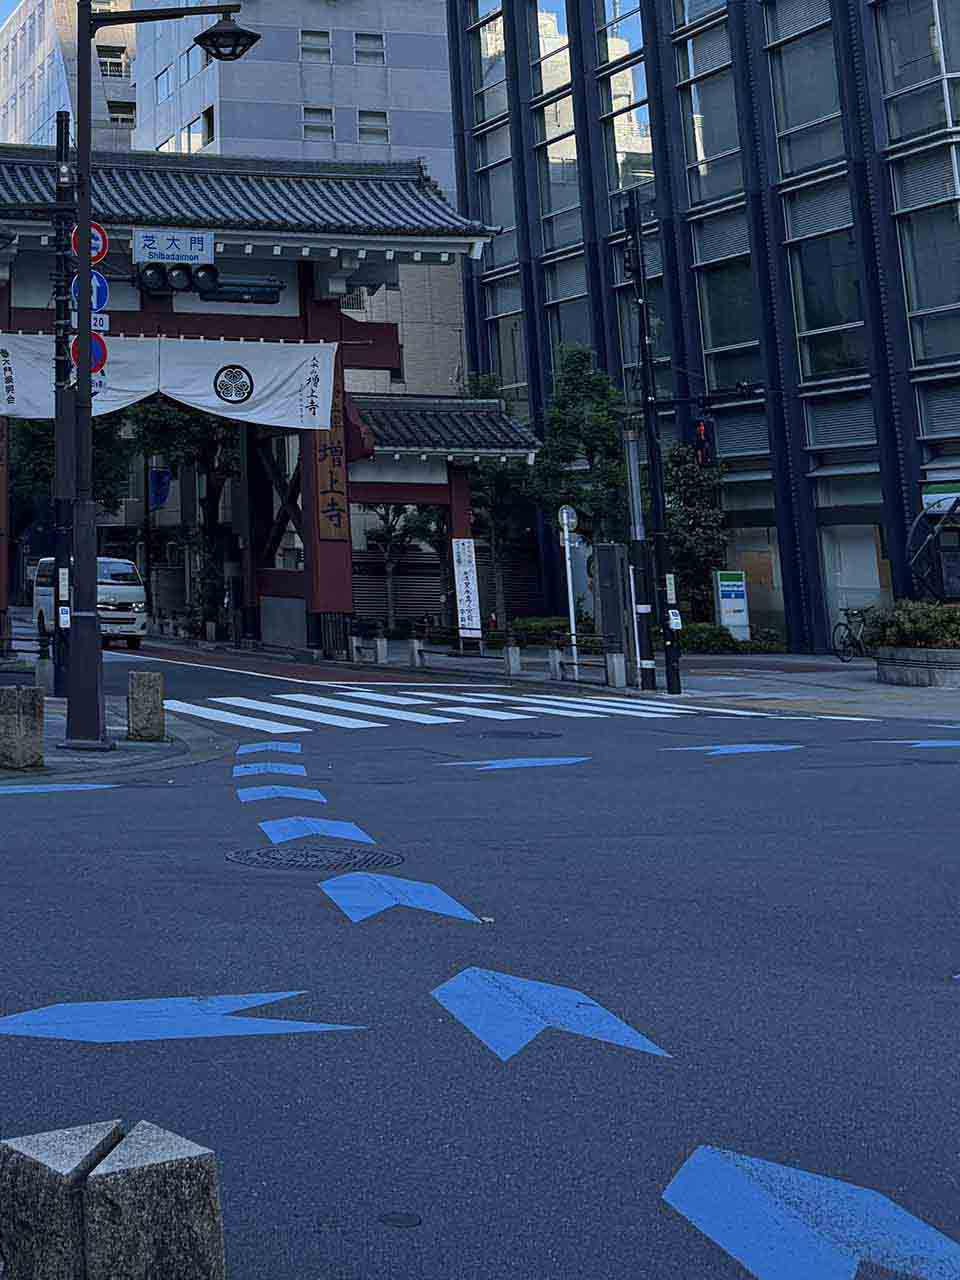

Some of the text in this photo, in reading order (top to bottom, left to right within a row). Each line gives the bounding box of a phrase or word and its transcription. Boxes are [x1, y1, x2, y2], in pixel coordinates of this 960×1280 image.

[142, 234, 205, 252] 芝大門
[148, 251, 200, 262] Shibadaimon
